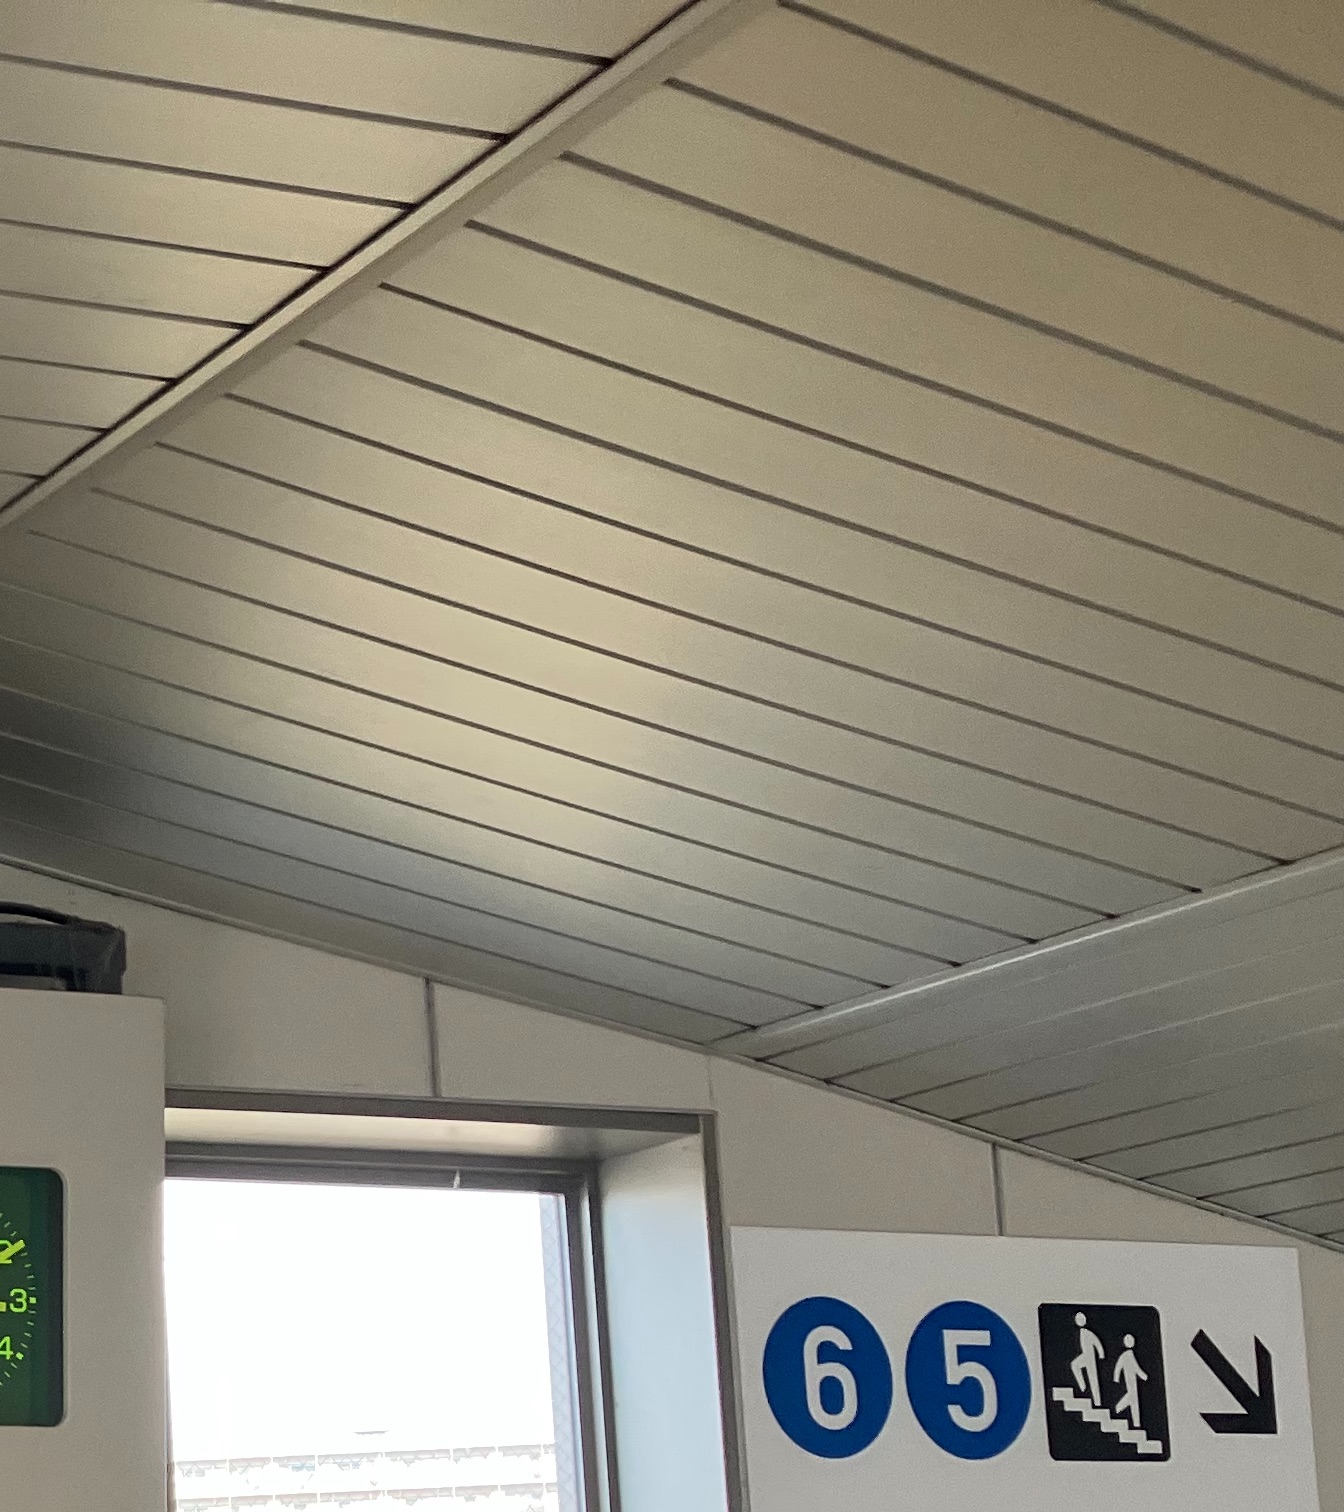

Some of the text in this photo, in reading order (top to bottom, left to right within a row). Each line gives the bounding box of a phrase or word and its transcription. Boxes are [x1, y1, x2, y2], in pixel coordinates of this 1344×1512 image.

[9, 1289, 27, 1313] 3
[803, 1325, 998, 1432] 6 5
